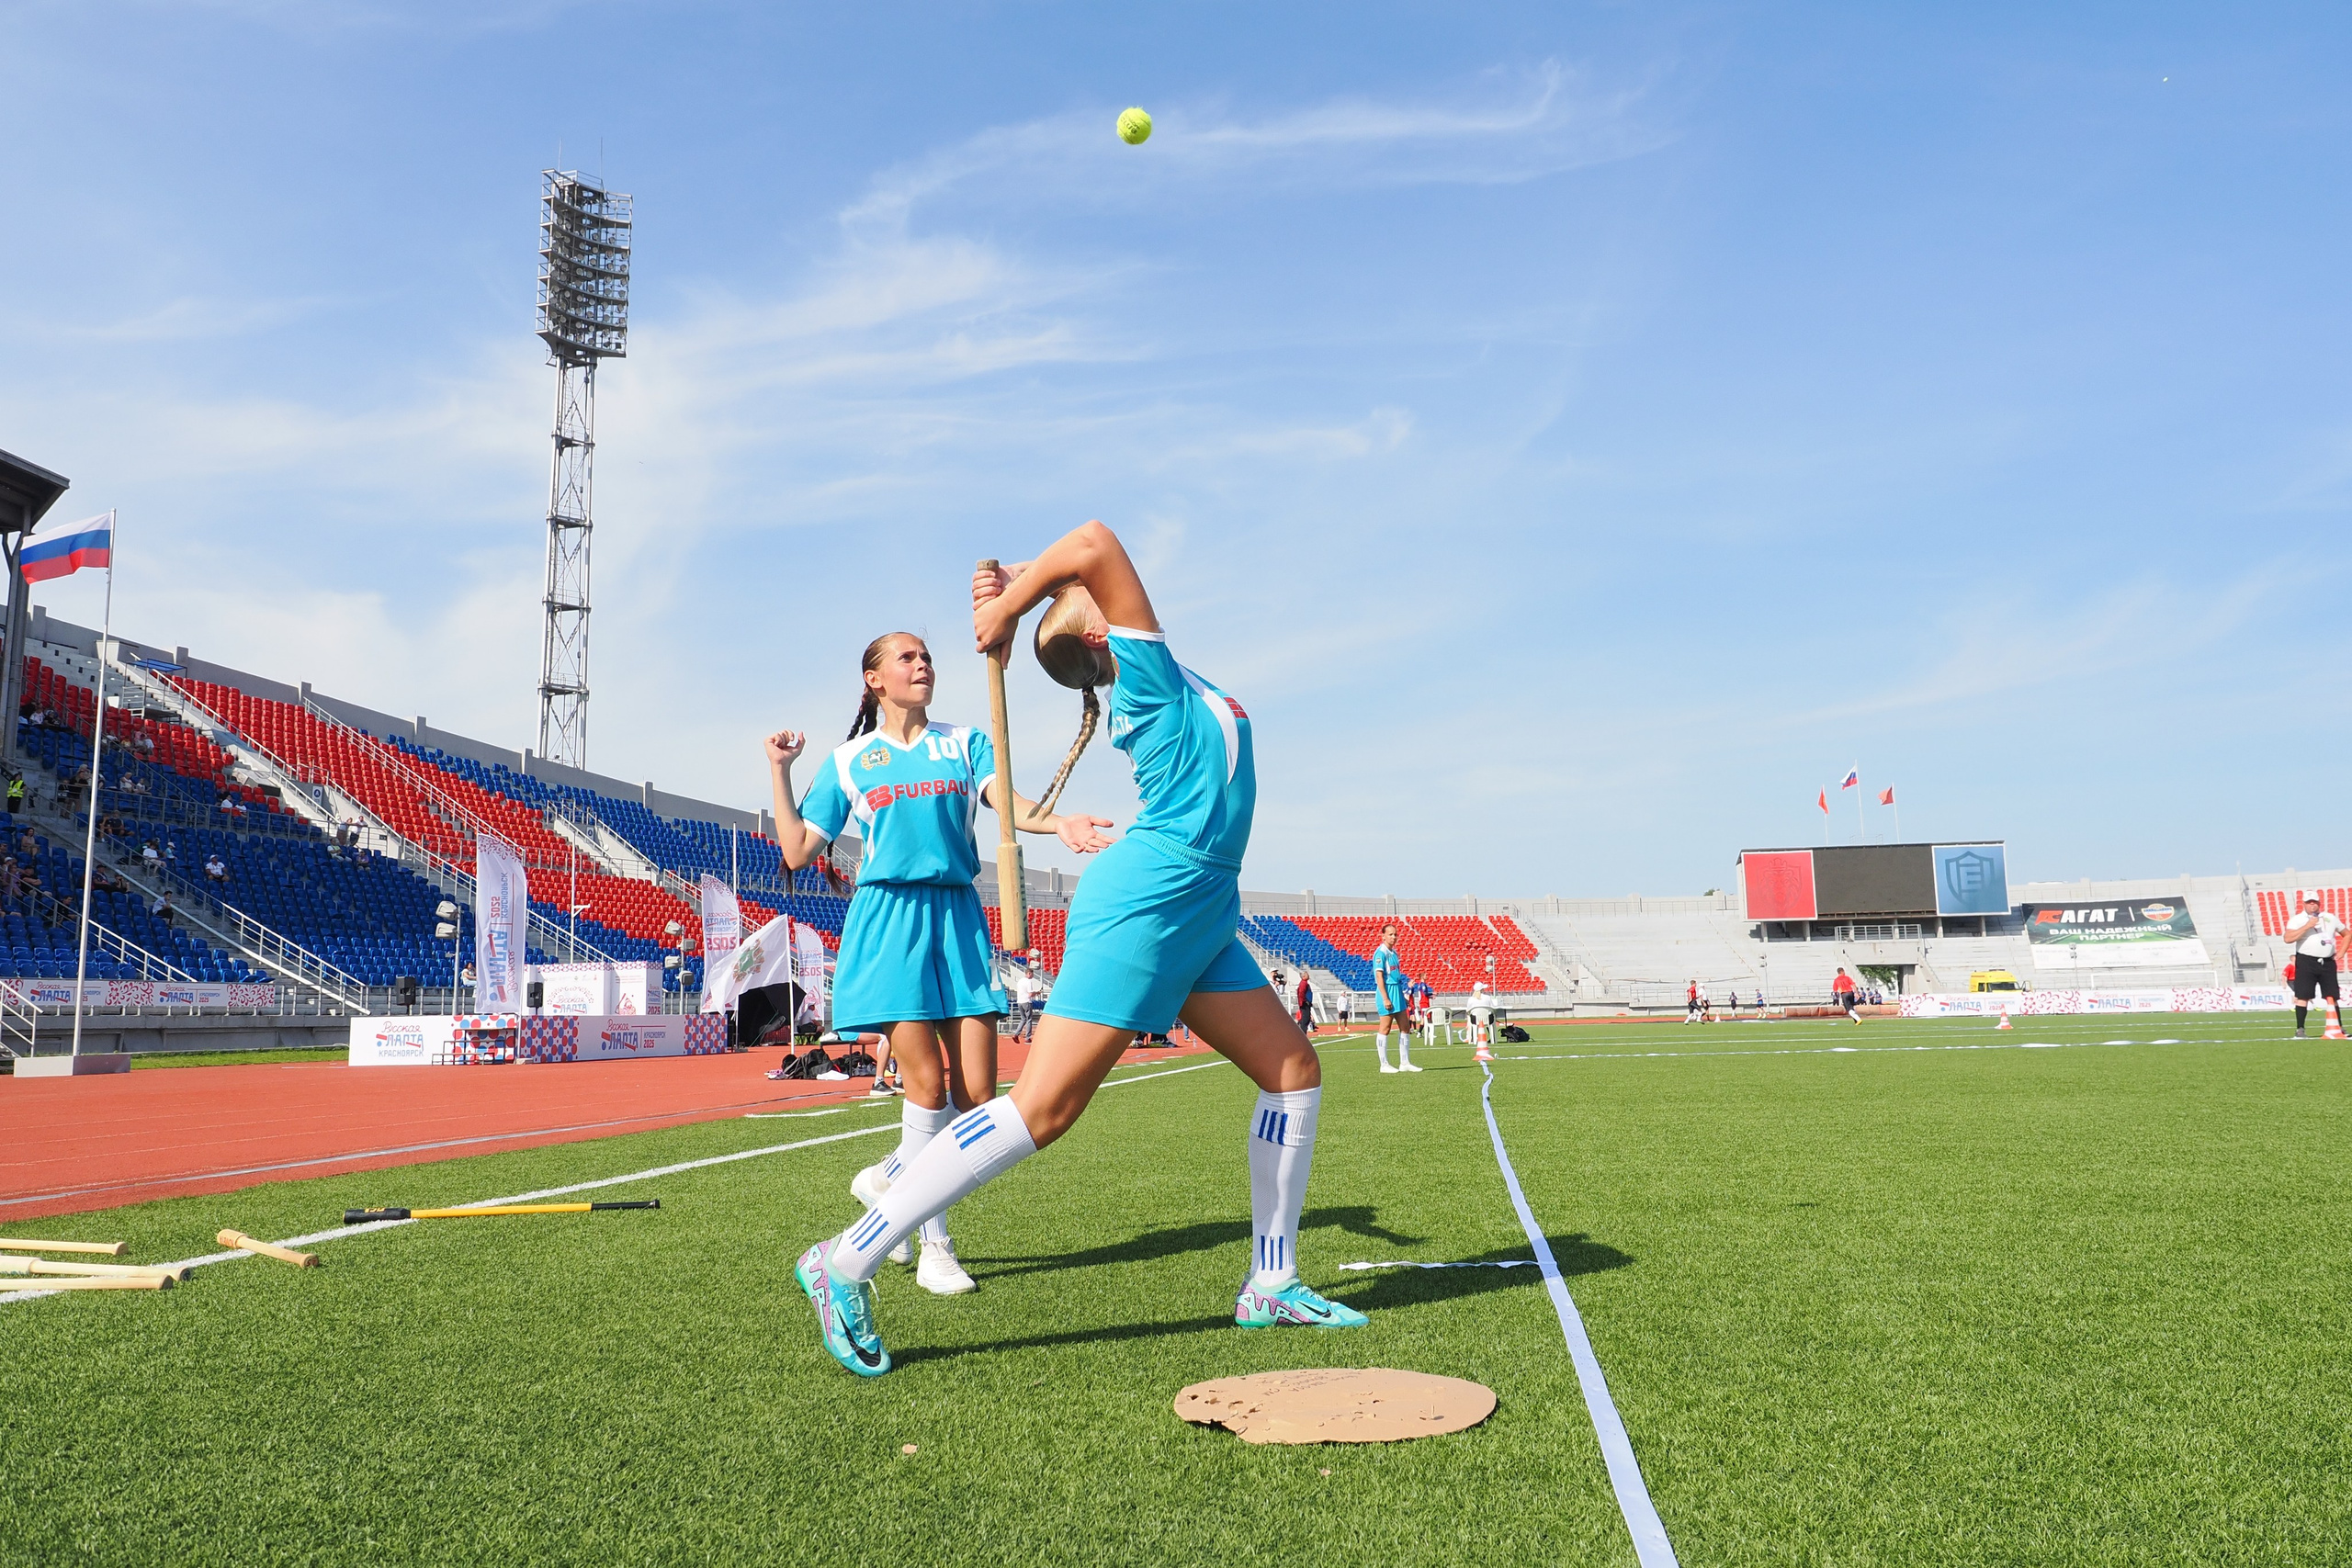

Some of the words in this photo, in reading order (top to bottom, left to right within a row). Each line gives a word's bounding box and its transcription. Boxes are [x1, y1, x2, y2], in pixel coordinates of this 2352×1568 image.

[924, 736, 959, 761] 10
[893, 779, 969, 800] FURBAU
[2060, 908, 2119, 923] АГАТ
[2079, 933, 2144, 942] ПАРТНЕР
[643, 1039, 655, 1049] 2025
[379, 1049, 424, 1057] КРАСНОЯРСК
